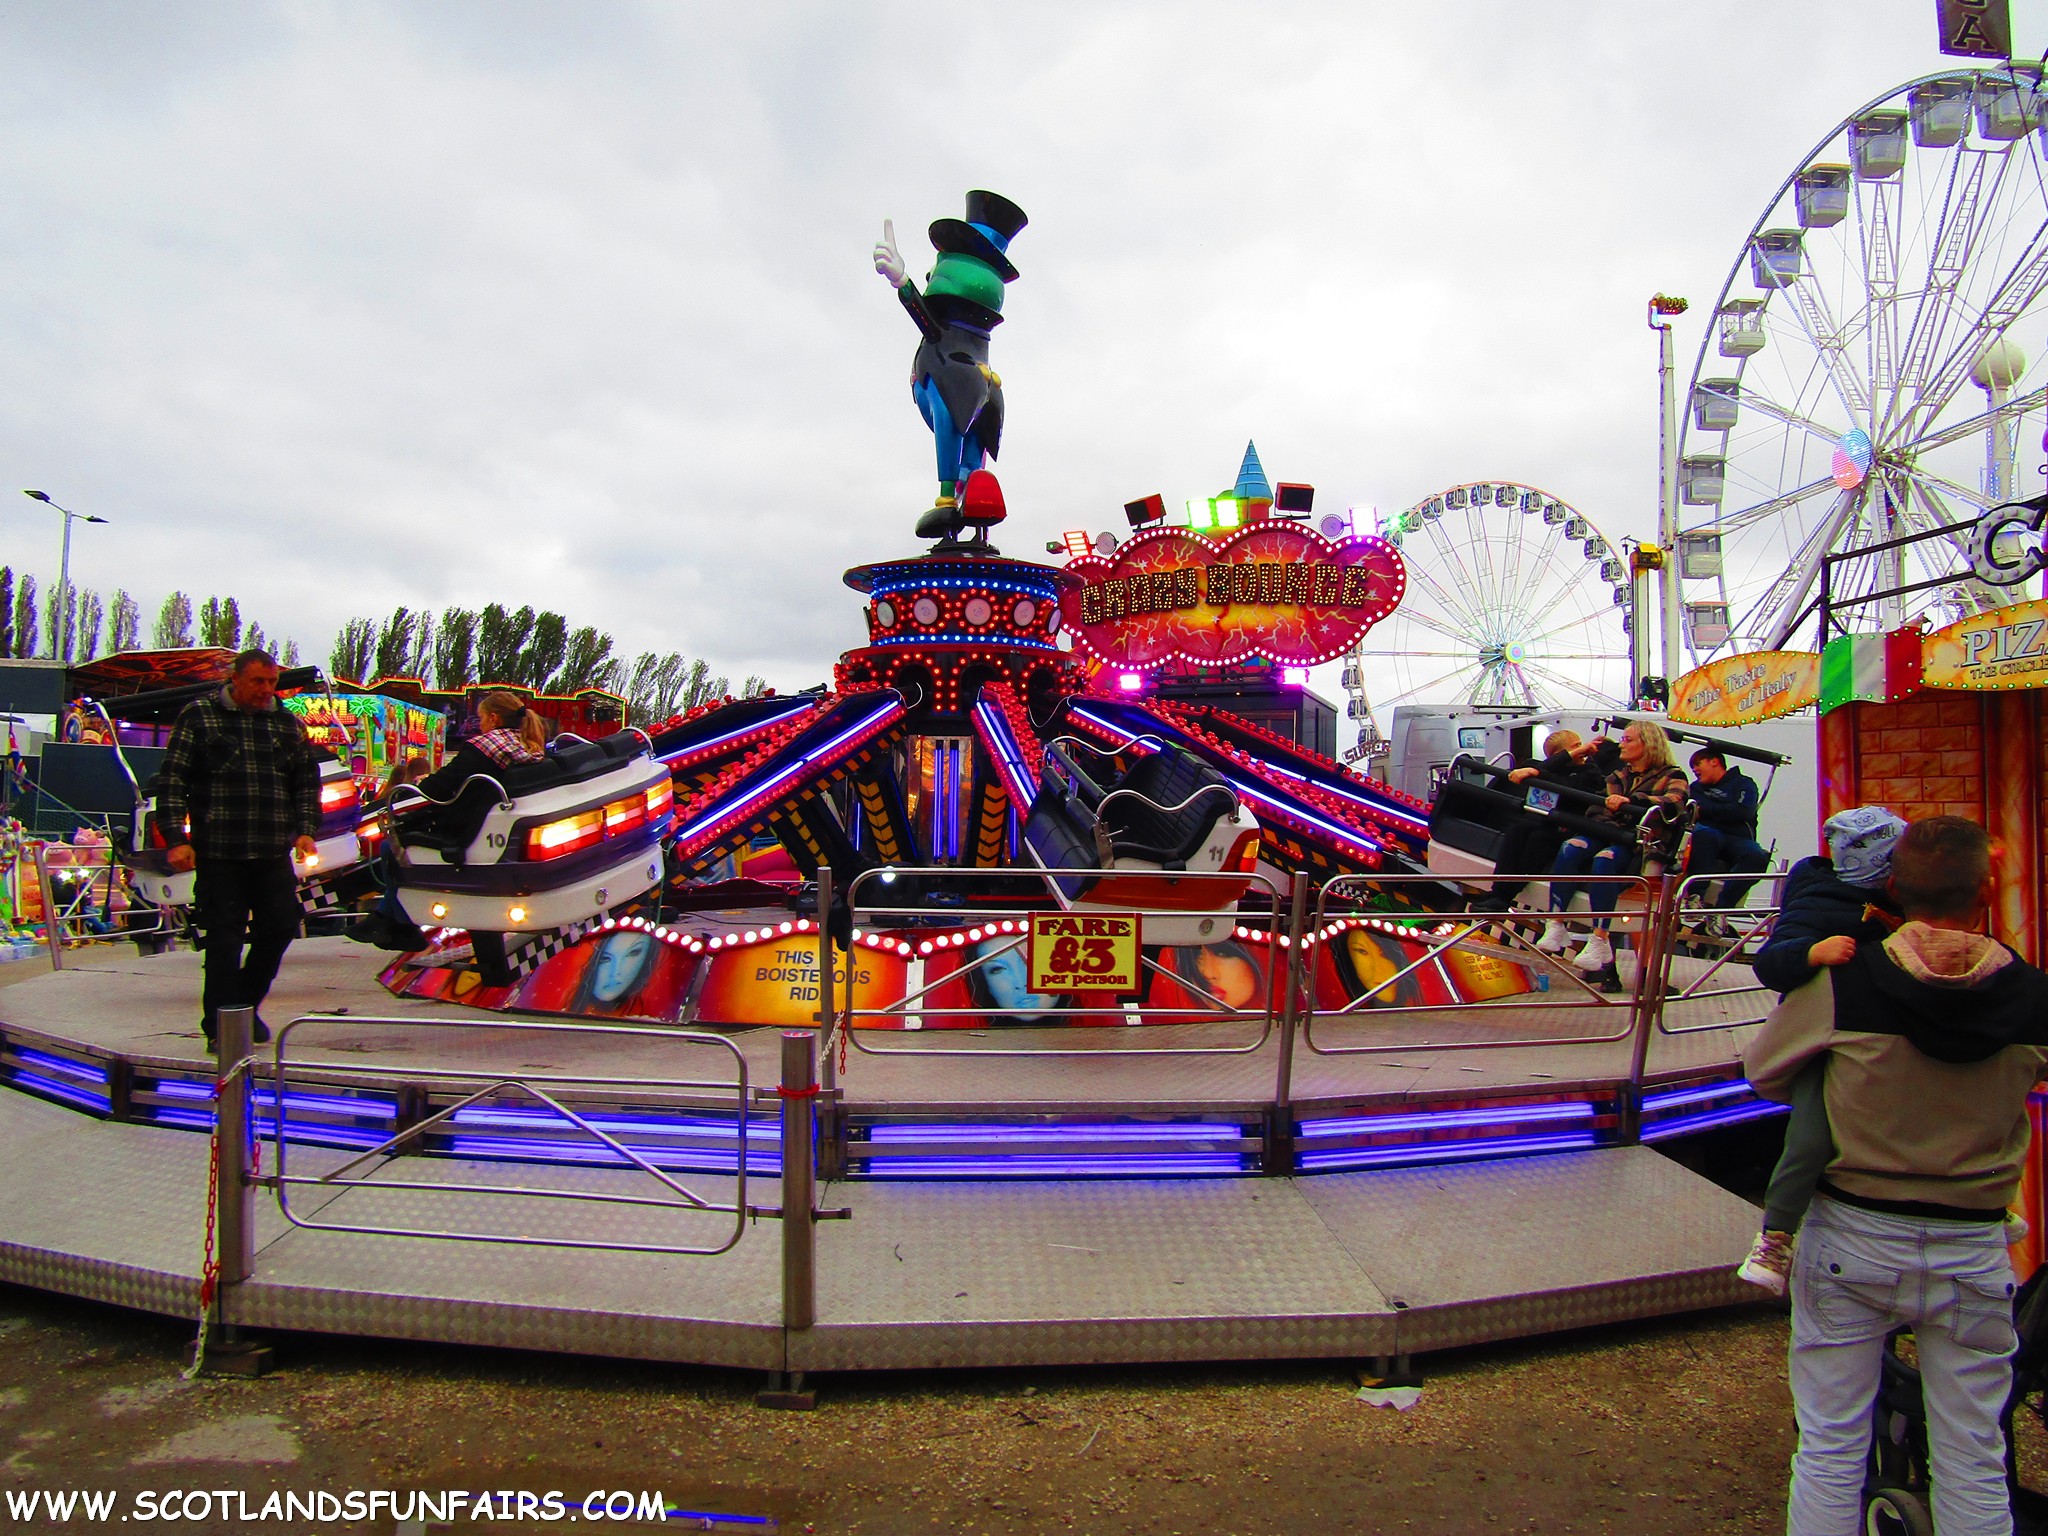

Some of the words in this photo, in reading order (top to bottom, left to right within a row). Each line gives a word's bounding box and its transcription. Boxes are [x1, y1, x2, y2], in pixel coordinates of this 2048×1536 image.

[1080, 567, 1197, 625] CRAZY
[1206, 563, 1368, 607] BOUNCE
[1961, 619, 2048, 668] PIZ
[1970, 666, 1997, 680] THE
[1691, 688, 1721, 711] The
[1724, 664, 1766, 695] Taste
[1738, 687, 1757, 712] of
[1757, 671, 1796, 702] Italy
[486, 833, 507, 848] 10
[1209, 846, 1225, 861] 11
[1037, 918, 1132, 936] FARE
[775, 950, 814, 965] THIS
[1049, 936, 1116, 974] £3
[1040, 974, 1068, 987] per
[1072, 974, 1128, 987] person
[789, 986, 822, 1001] RID
